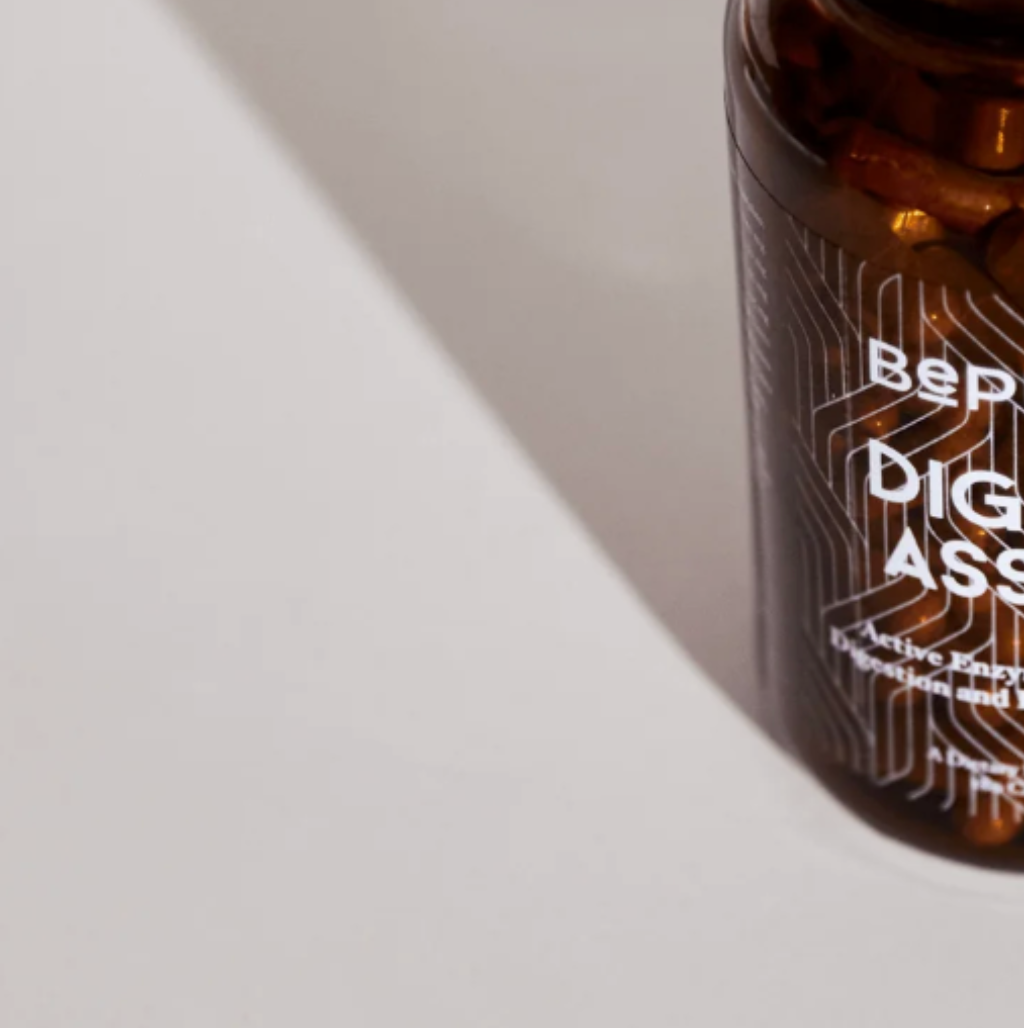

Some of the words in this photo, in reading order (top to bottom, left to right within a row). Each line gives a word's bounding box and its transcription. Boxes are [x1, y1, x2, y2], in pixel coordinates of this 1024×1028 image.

[829, 624, 951, 699] Digestion
[956, 686, 1010, 709] and
[861, 620, 943, 667] Active
